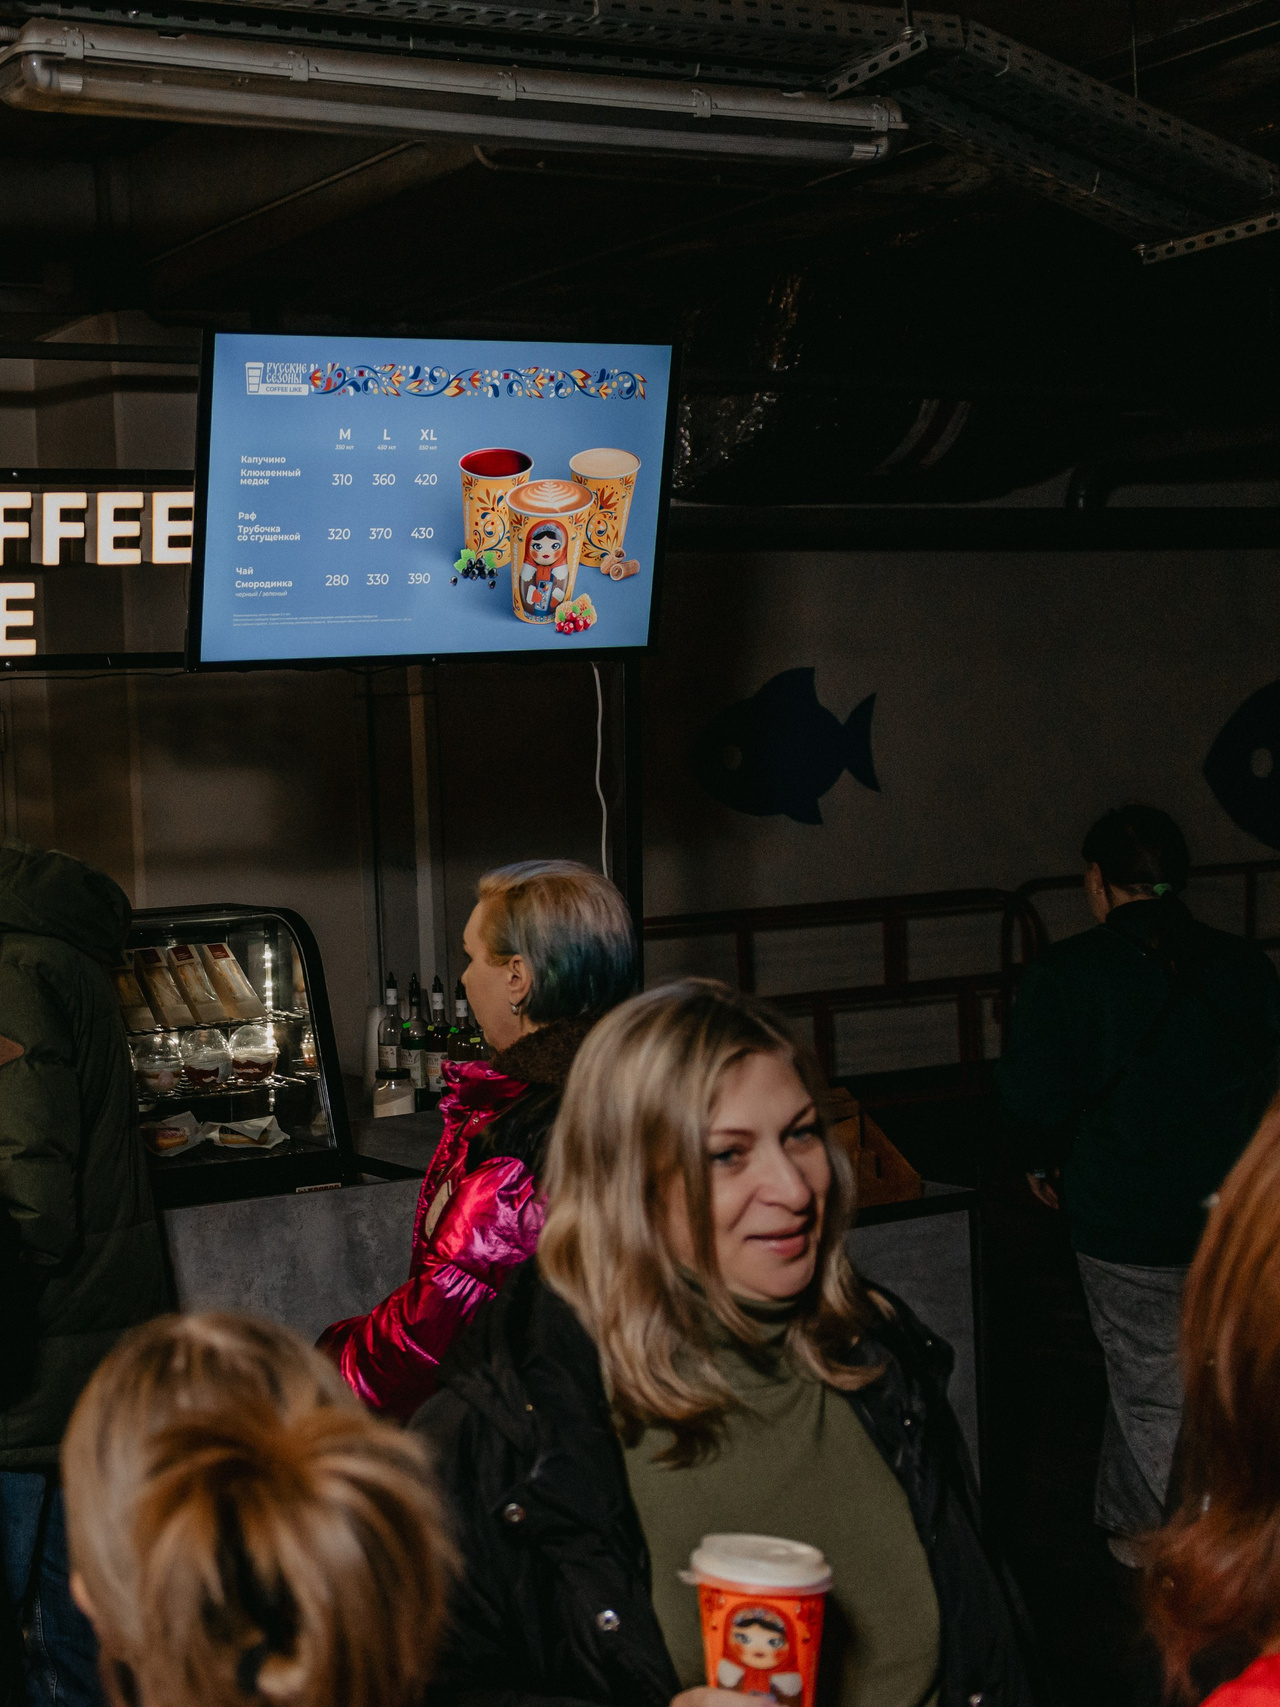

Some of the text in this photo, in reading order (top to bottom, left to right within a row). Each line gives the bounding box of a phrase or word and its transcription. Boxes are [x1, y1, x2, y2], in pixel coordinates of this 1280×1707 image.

[267, 362, 307, 373] РУССКИЕ
[266, 373, 302, 383] СЕЗОНЫ
[339, 428, 437, 441] M L XL
[241, 456, 286, 465] Капучино
[240, 469, 301, 478] Клюквенный
[240, 478, 269, 486] медок
[332, 474, 438, 486] 310 360 420
[238, 512, 256, 522] Раф
[238, 525, 280, 534] Трубочка
[328, 527, 434, 540] 320 370 430
[250, 533, 300, 543] сгущенкой
[236, 567, 253, 575] Чай
[235, 580, 292, 589] Смородинка
[325, 573, 431, 586] 280 330 390
